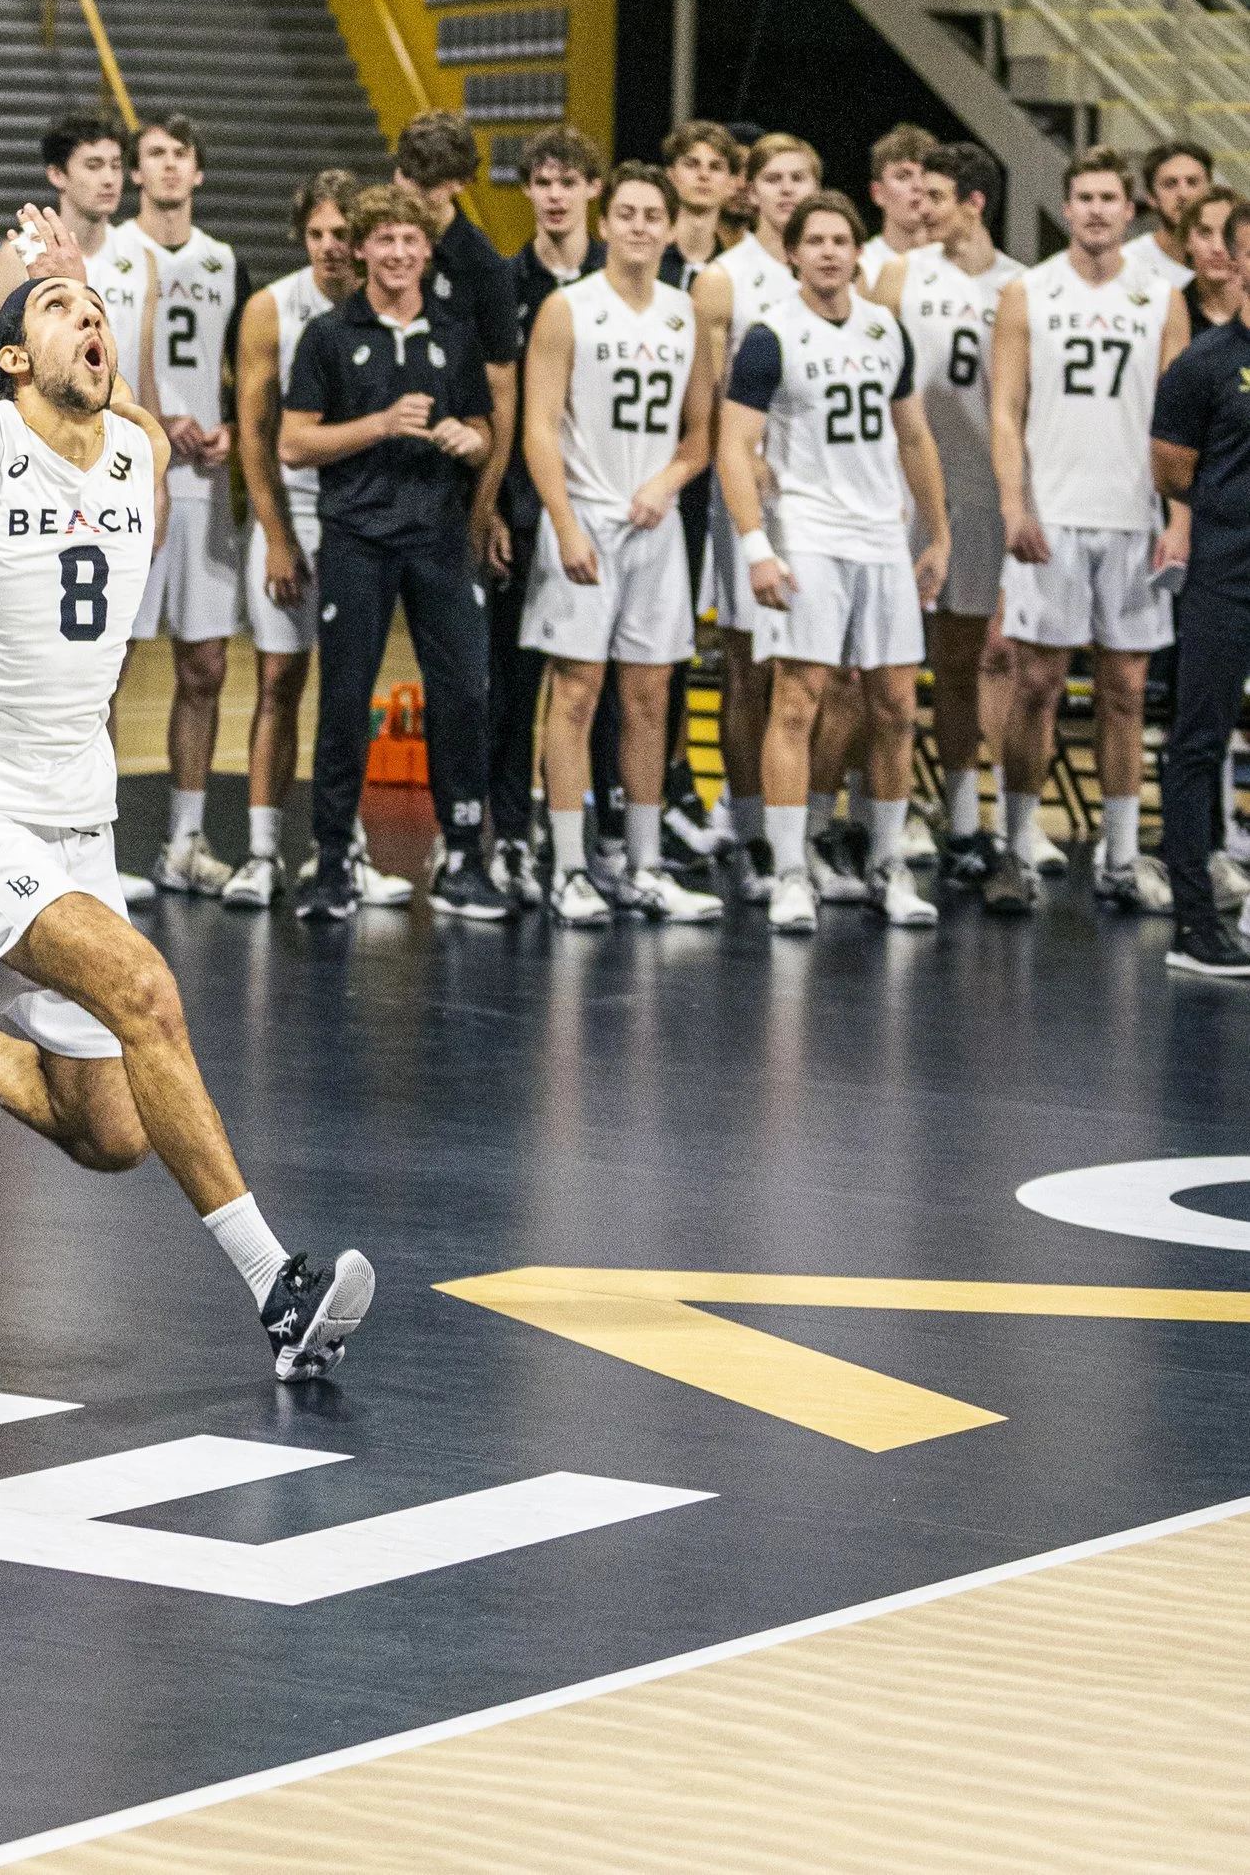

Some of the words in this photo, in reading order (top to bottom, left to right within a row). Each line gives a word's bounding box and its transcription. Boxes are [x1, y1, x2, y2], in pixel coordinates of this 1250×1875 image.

[168, 306, 197, 368] 2
[920, 301, 996, 326] BEAC
[1049, 313, 1146, 337] BEACH
[597, 342, 685, 363] BEACH
[806, 357, 891, 380] BEACH
[950, 327, 979, 387] 6
[1063, 337, 1131, 398] 27
[612, 368, 673, 433] 22
[825, 382, 883, 444] 26
[8, 509, 142, 535] BEACH
[58, 544, 110, 642] 8
